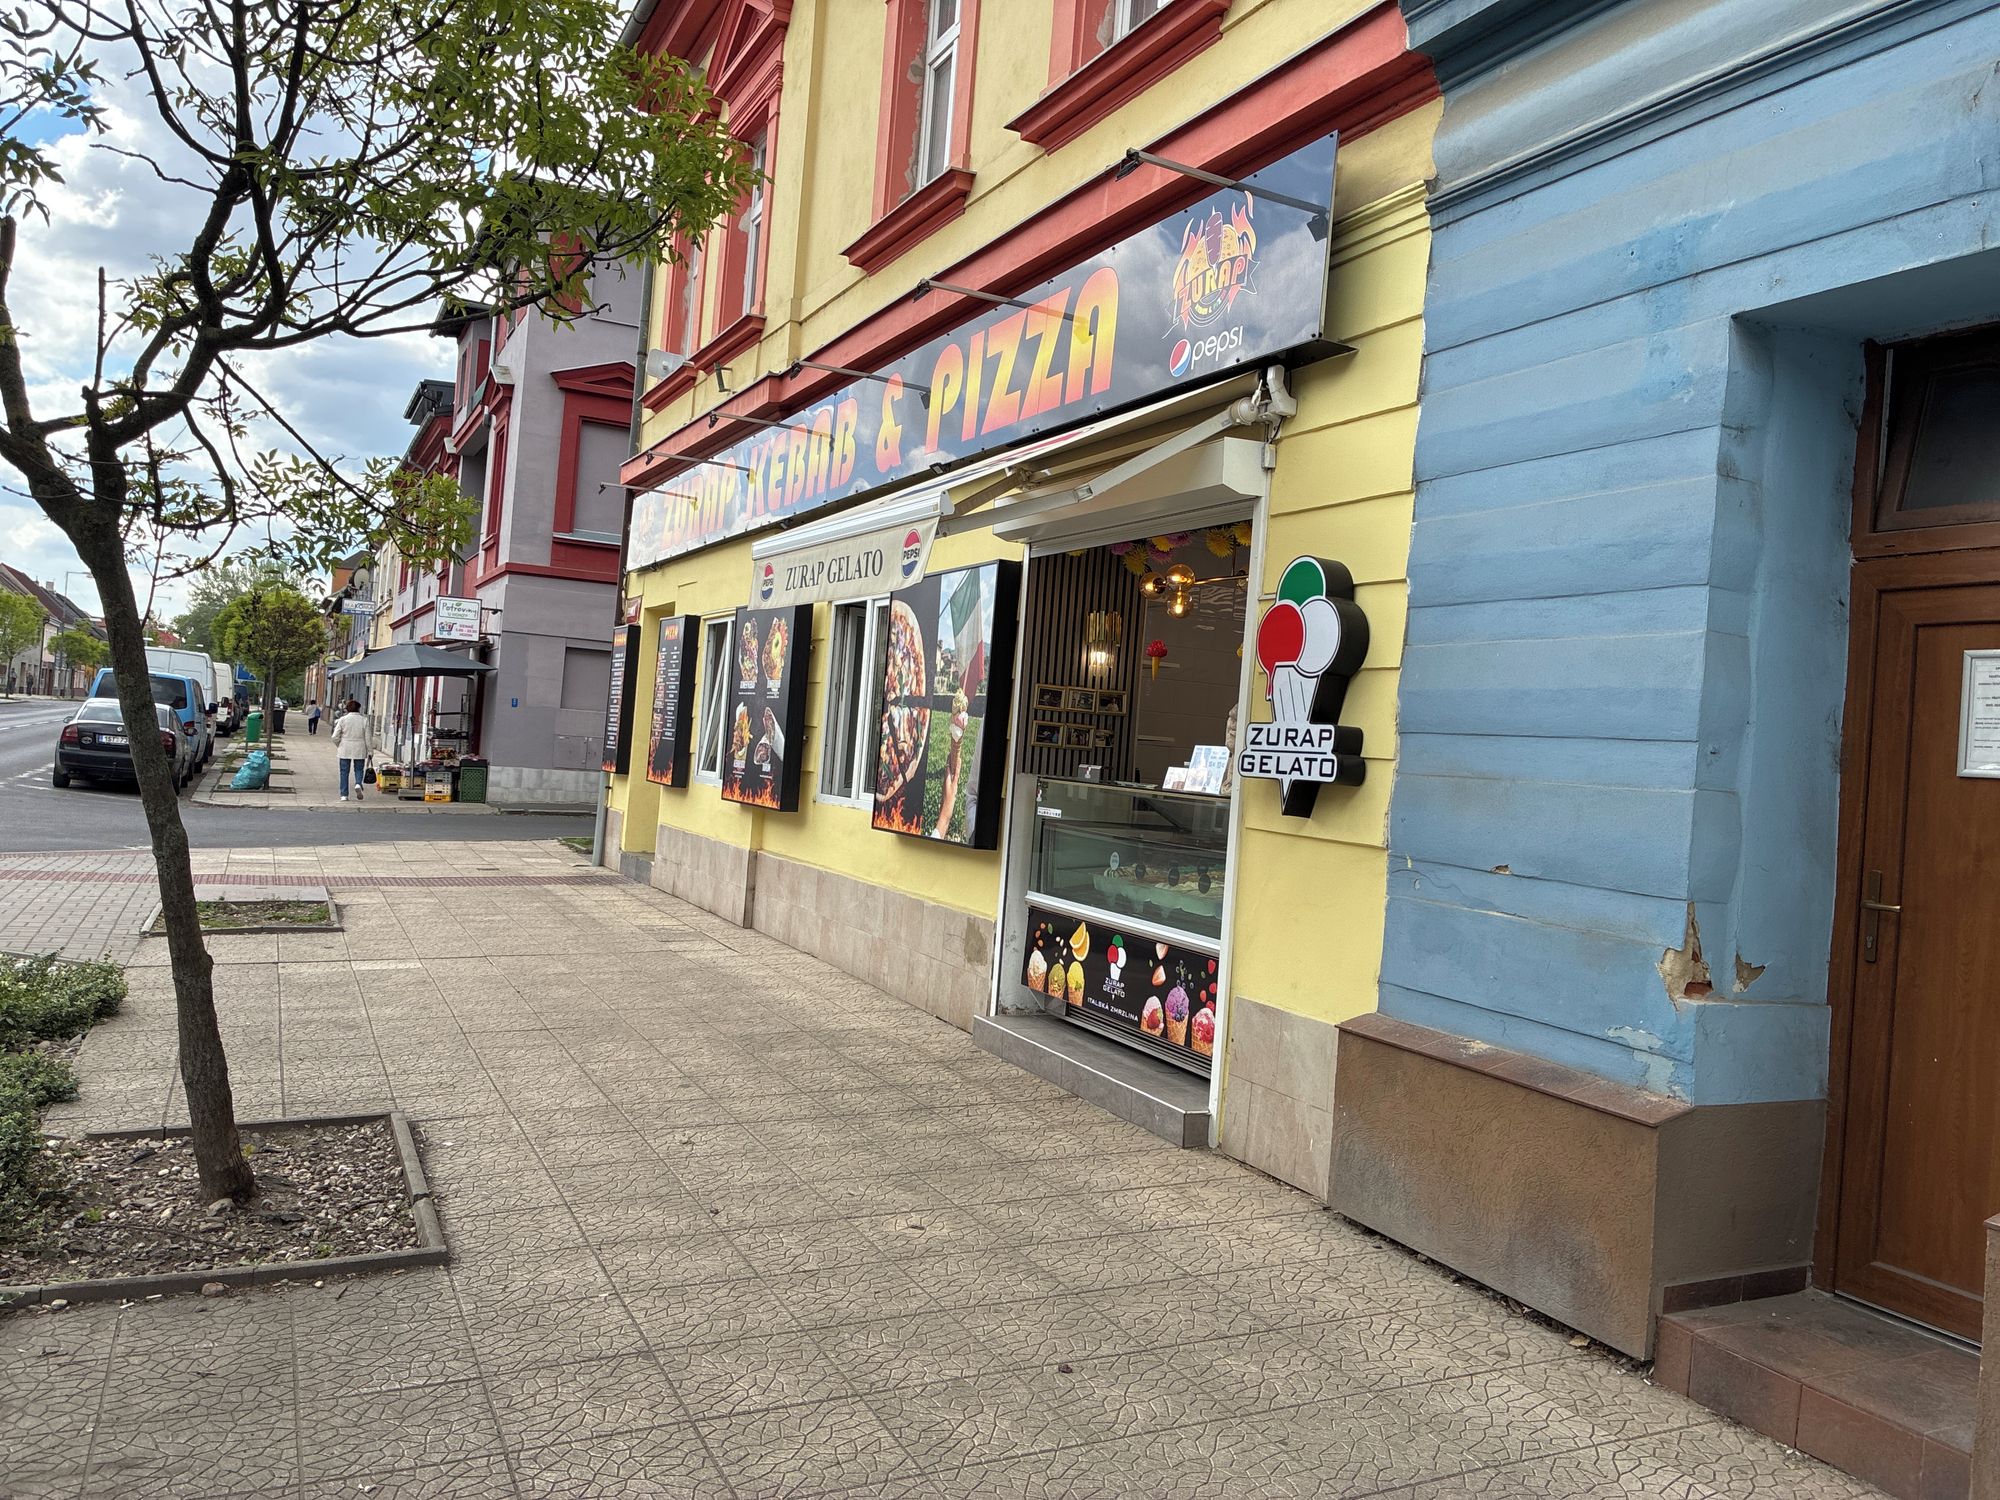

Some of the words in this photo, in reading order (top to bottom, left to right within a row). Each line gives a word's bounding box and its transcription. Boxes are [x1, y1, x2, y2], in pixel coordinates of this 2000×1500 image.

[1178, 256, 1246, 315] ZURAP
[1191, 325, 1244, 370] pepsi
[663, 466, 737, 549] ZURAP
[745, 397, 858, 519] KEBAB
[875, 373, 904, 474] &
[925, 267, 1119, 453] PIZZA
[903, 547, 920, 560] PEPSI
[785, 561, 825, 591] ZURAP
[827, 548, 884, 585] GELATO
[762, 577, 774, 587] PEPSI
[1250, 727, 1333, 748] ZURAP
[1240, 754, 1336, 778] GELATO
[1102, 984, 1126, 998] GELATO
[1105, 977, 1125, 988] ZURAP
[1087, 997, 1109, 1010] ITALSKÁ
[1110, 1006, 1139, 1021] ZMRZLINA
